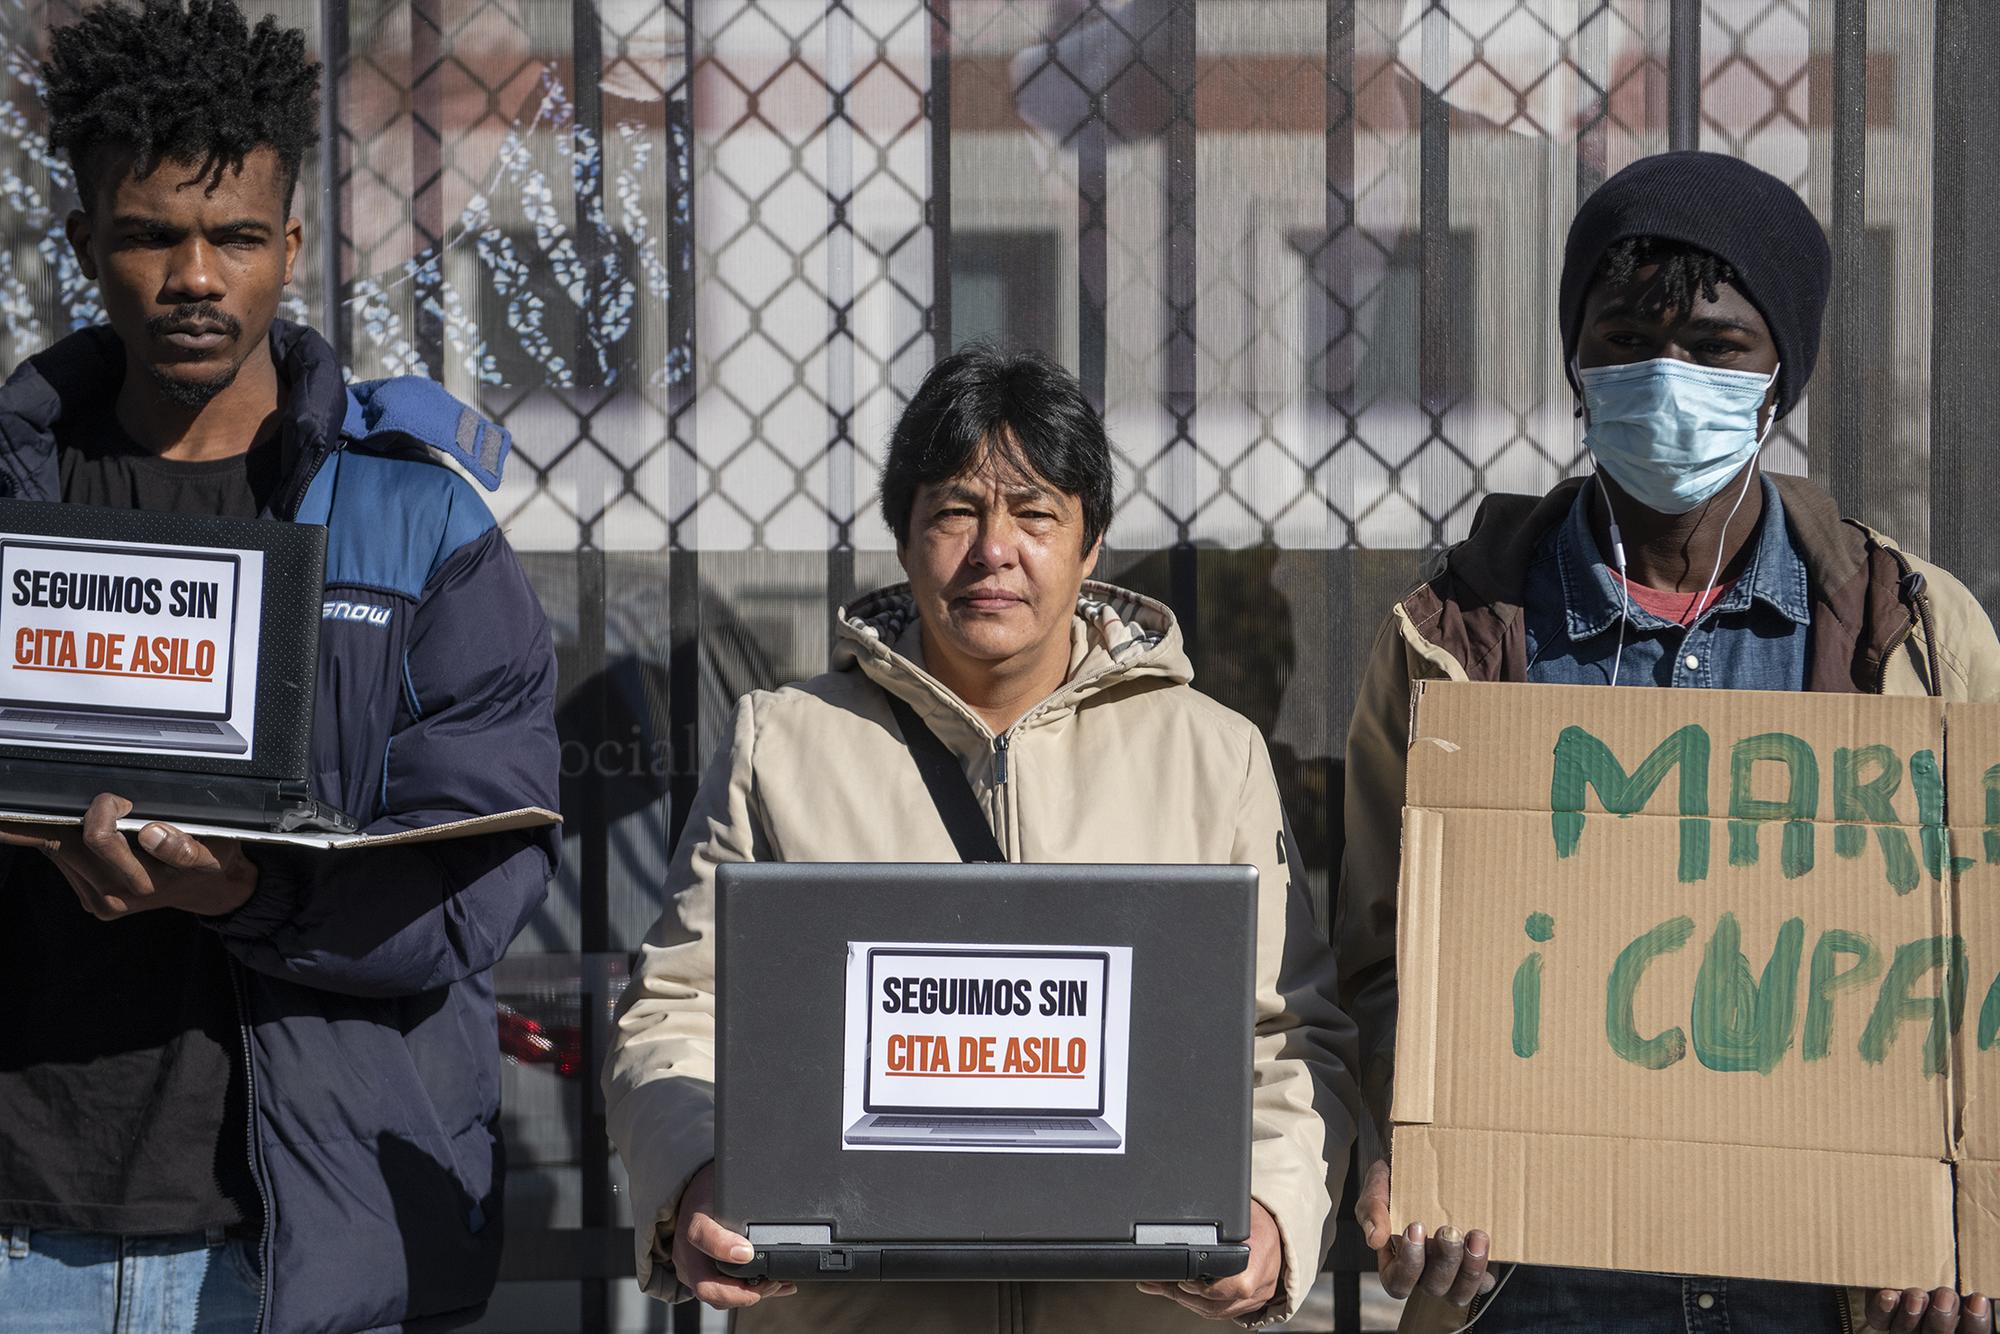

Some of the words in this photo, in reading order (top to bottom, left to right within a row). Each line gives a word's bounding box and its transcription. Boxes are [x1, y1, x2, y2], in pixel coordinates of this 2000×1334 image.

[12, 568, 163, 616] SEGUIMOS
[168, 579, 219, 619] SIN
[15, 627, 78, 668] CITA
[85, 631, 126, 671] DE
[129, 635, 216, 677] ASILO
[1551, 723, 2000, 897] MARL
[882, 976, 1032, 1017] SEGUIMOS
[1038, 979, 1088, 1017] SIN
[1605, 911, 2000, 1081] CUPA
[887, 1033, 951, 1073] CITA
[958, 1036, 997, 1073] DE
[1002, 1036, 1087, 1074] ASILO
